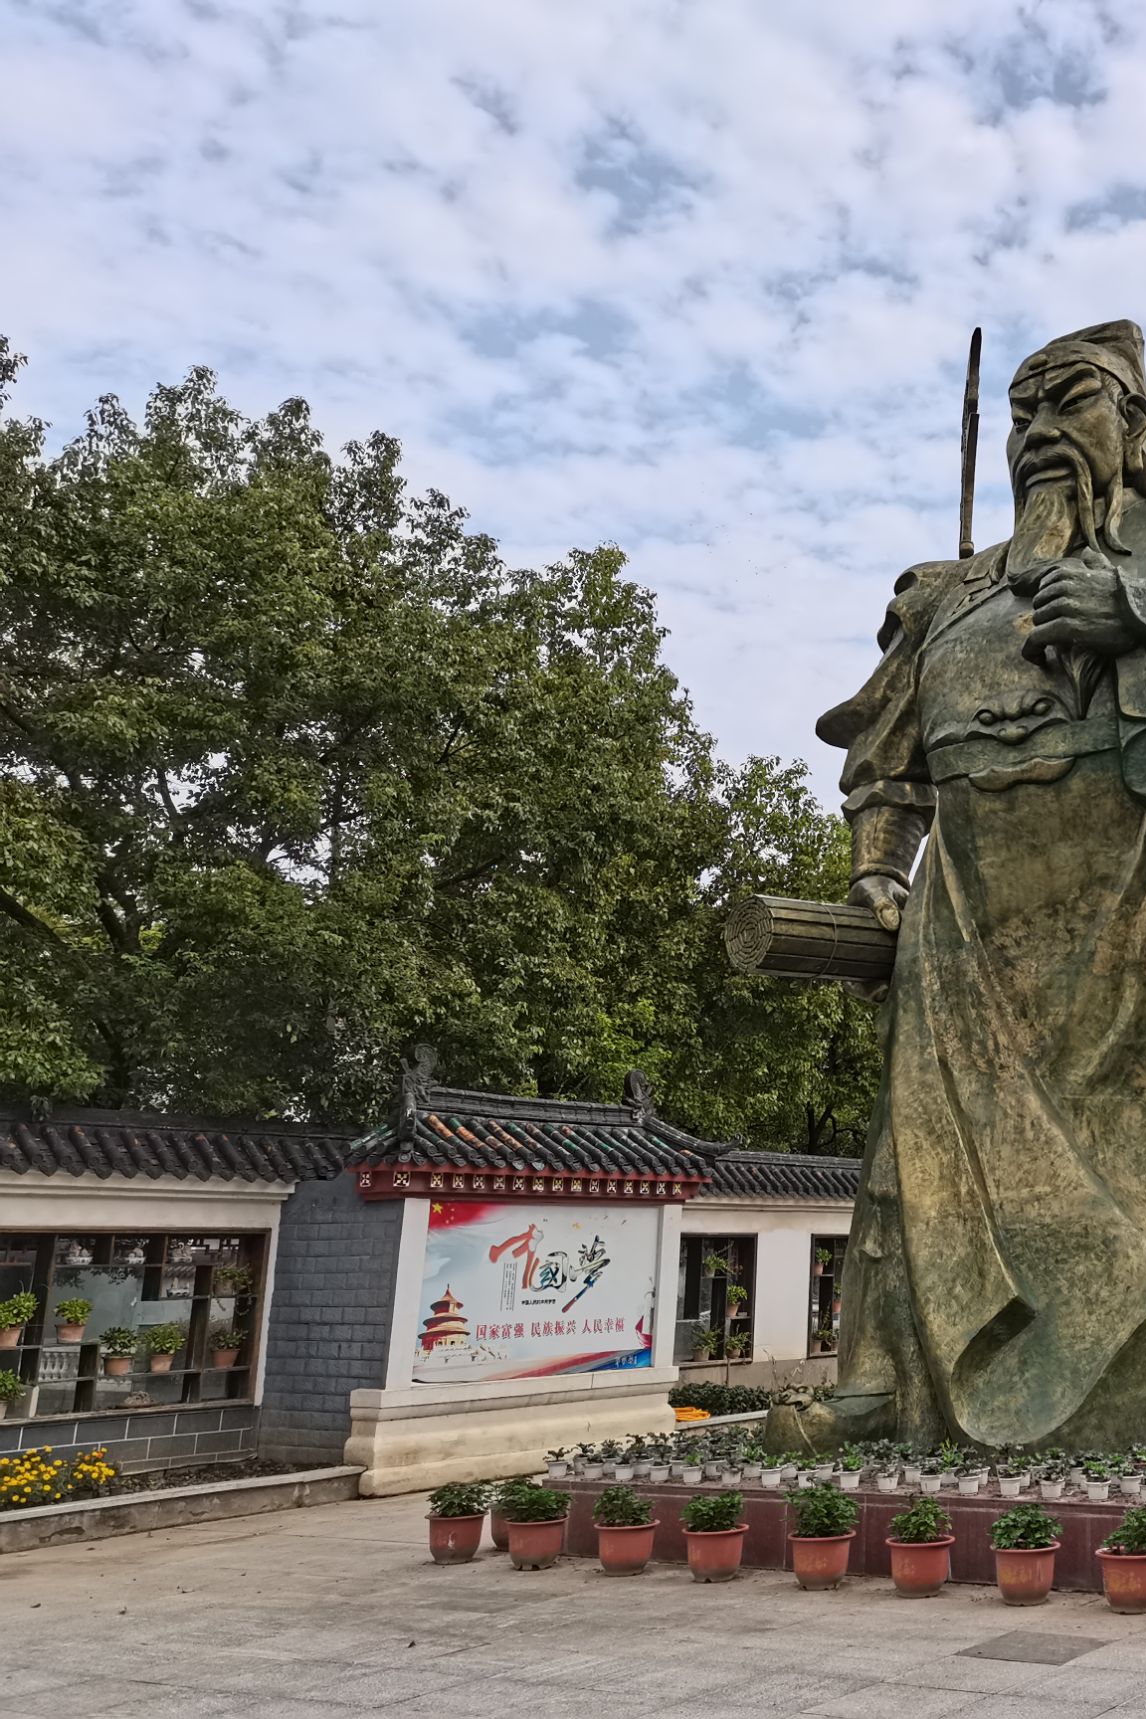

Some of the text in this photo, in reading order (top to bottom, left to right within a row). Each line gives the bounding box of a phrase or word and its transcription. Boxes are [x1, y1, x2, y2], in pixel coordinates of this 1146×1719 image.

[476, 1317, 625, 1340] 国家富强 民族振兴 人民幸福
